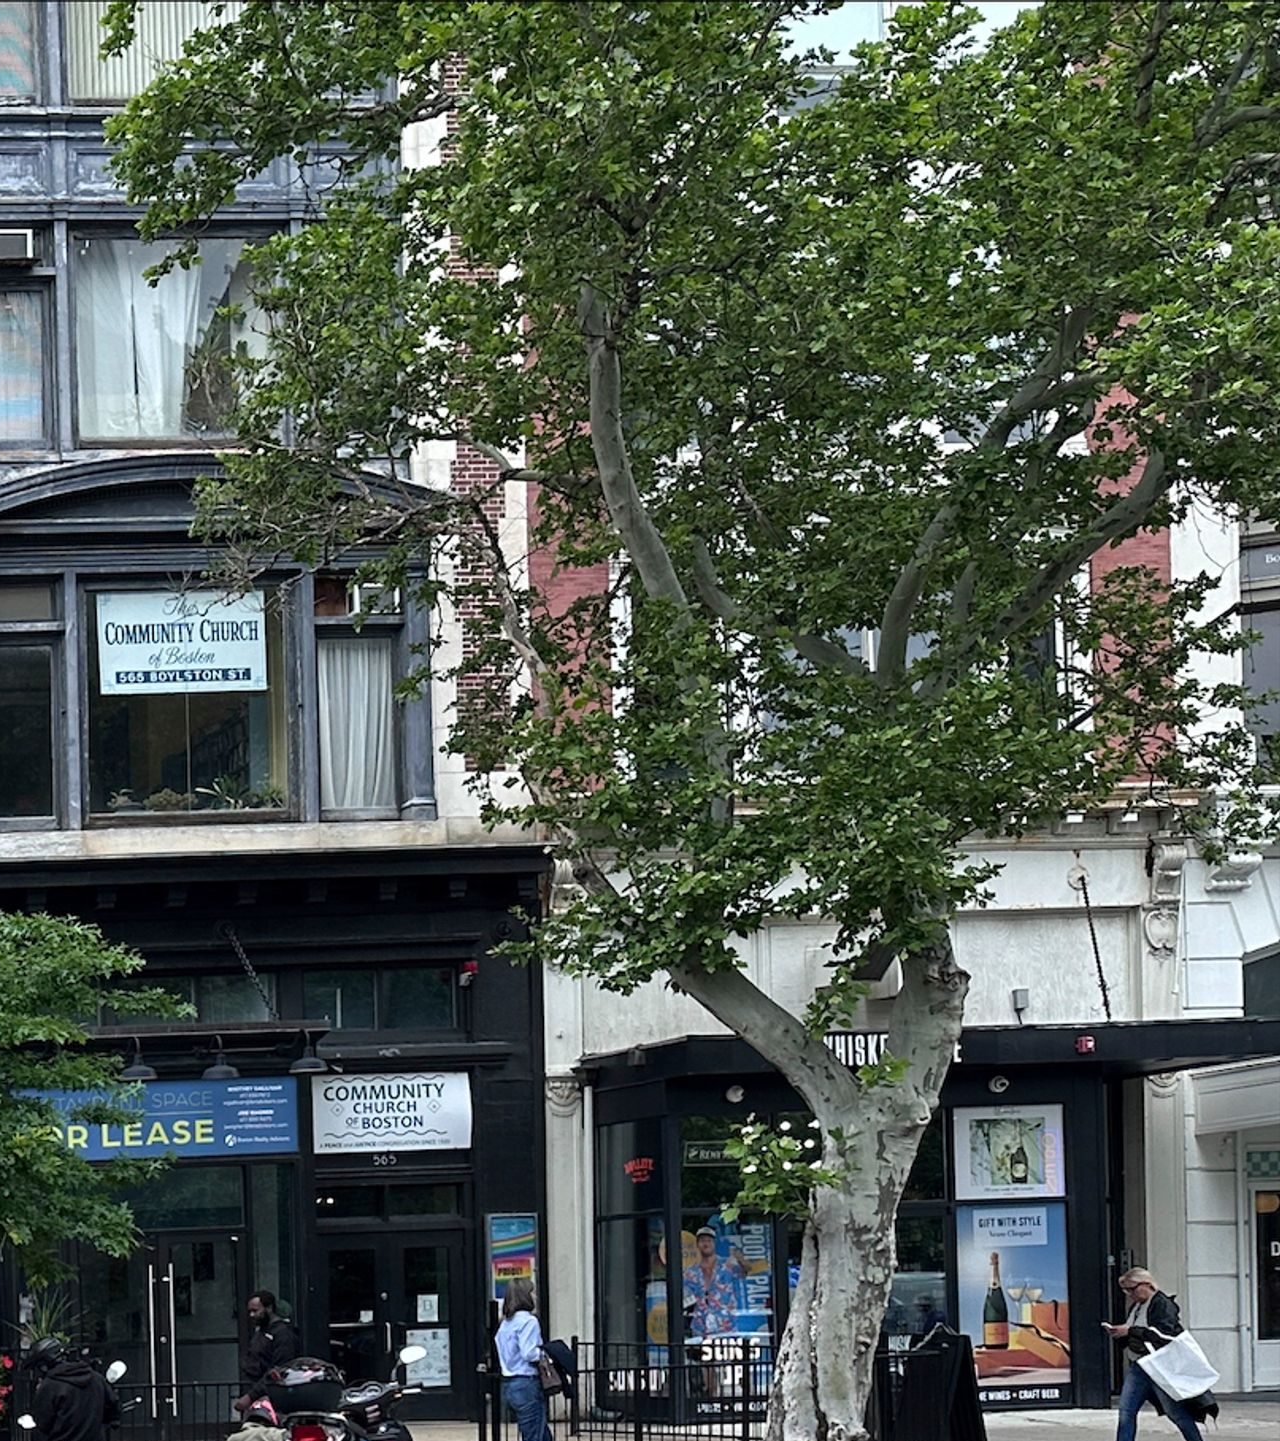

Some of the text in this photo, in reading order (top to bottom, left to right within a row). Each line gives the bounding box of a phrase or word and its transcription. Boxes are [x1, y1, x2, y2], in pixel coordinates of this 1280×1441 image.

[148, 645, 216, 669] of Boston
[119, 668, 248, 683] 565 BOYLSTON ST.
[323, 1083, 445, 1101] COMMUNITY
[151, 1091, 213, 1109] SPACE
[353, 1101, 417, 1114] CHURCH
[362, 1115, 424, 1130] BOSTON
[101, 1119, 215, 1148] LEASE
[978, 1215, 1042, 1228] GIFT WITH STYLE
[988, 1390, 1011, 1401] WINES
[1041, 1388, 1060, 1399] BEER
